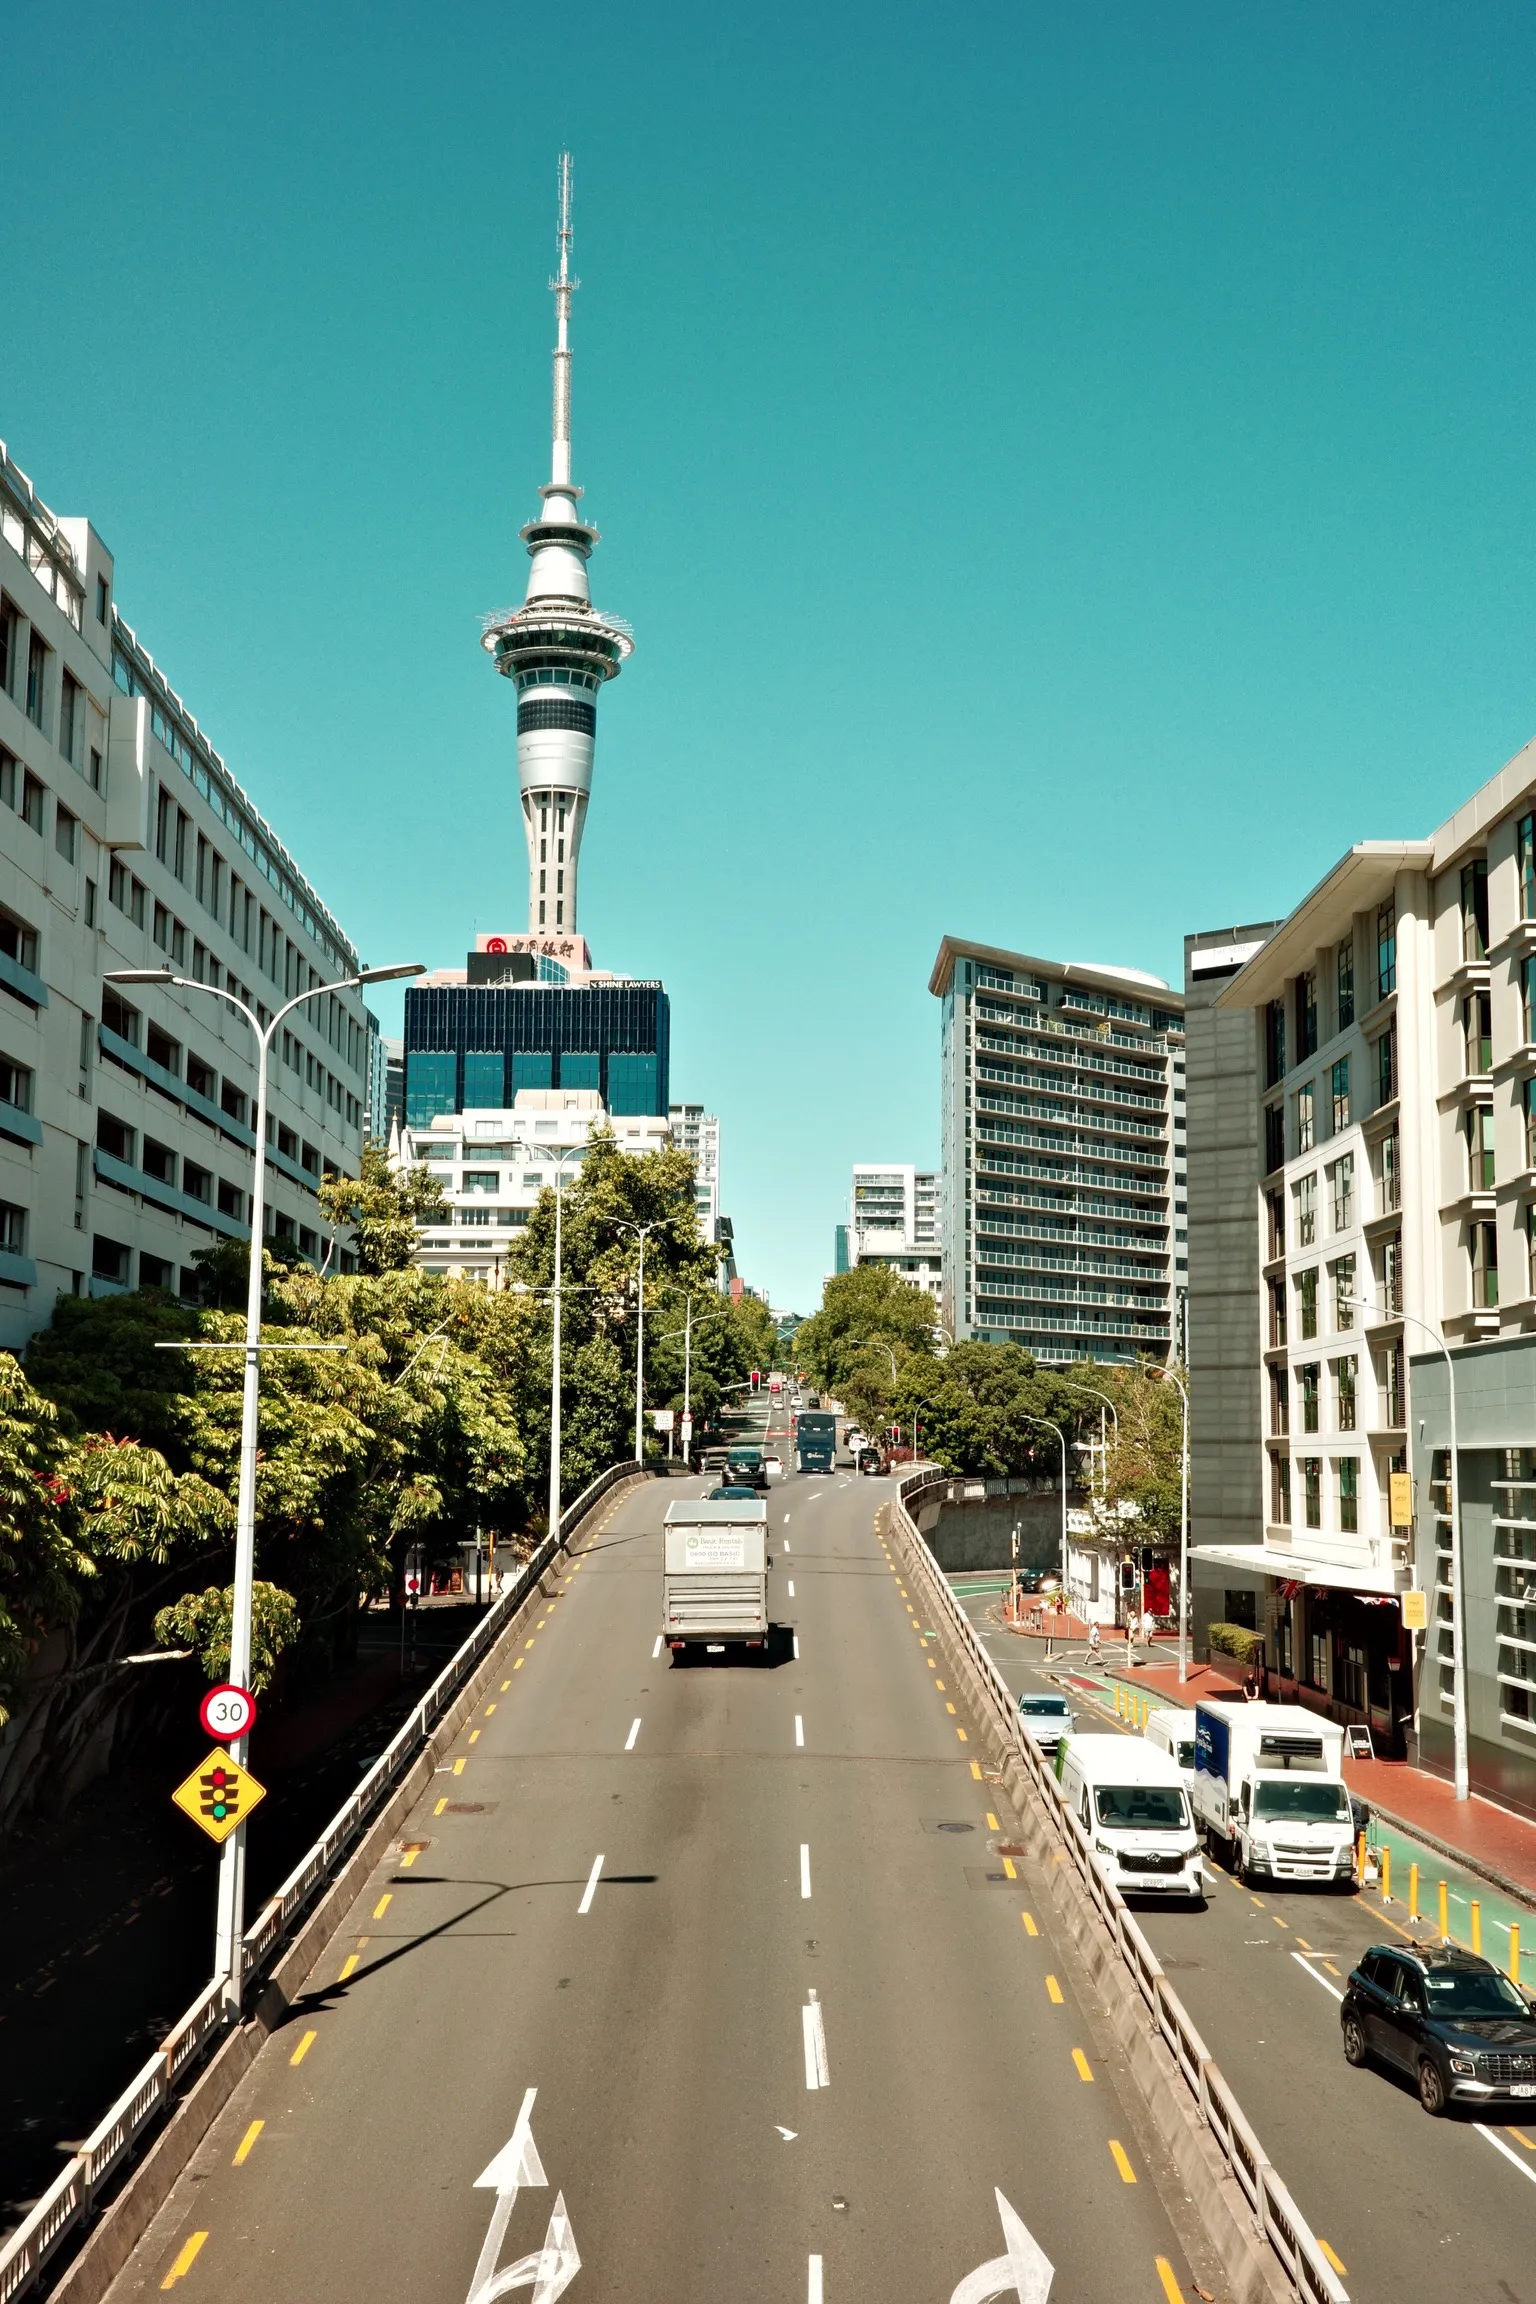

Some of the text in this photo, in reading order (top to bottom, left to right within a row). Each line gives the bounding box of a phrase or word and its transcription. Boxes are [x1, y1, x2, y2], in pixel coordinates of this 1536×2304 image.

[598, 980, 661, 989] SHINE LAWYERS
[216, 1702, 243, 1722] 30
